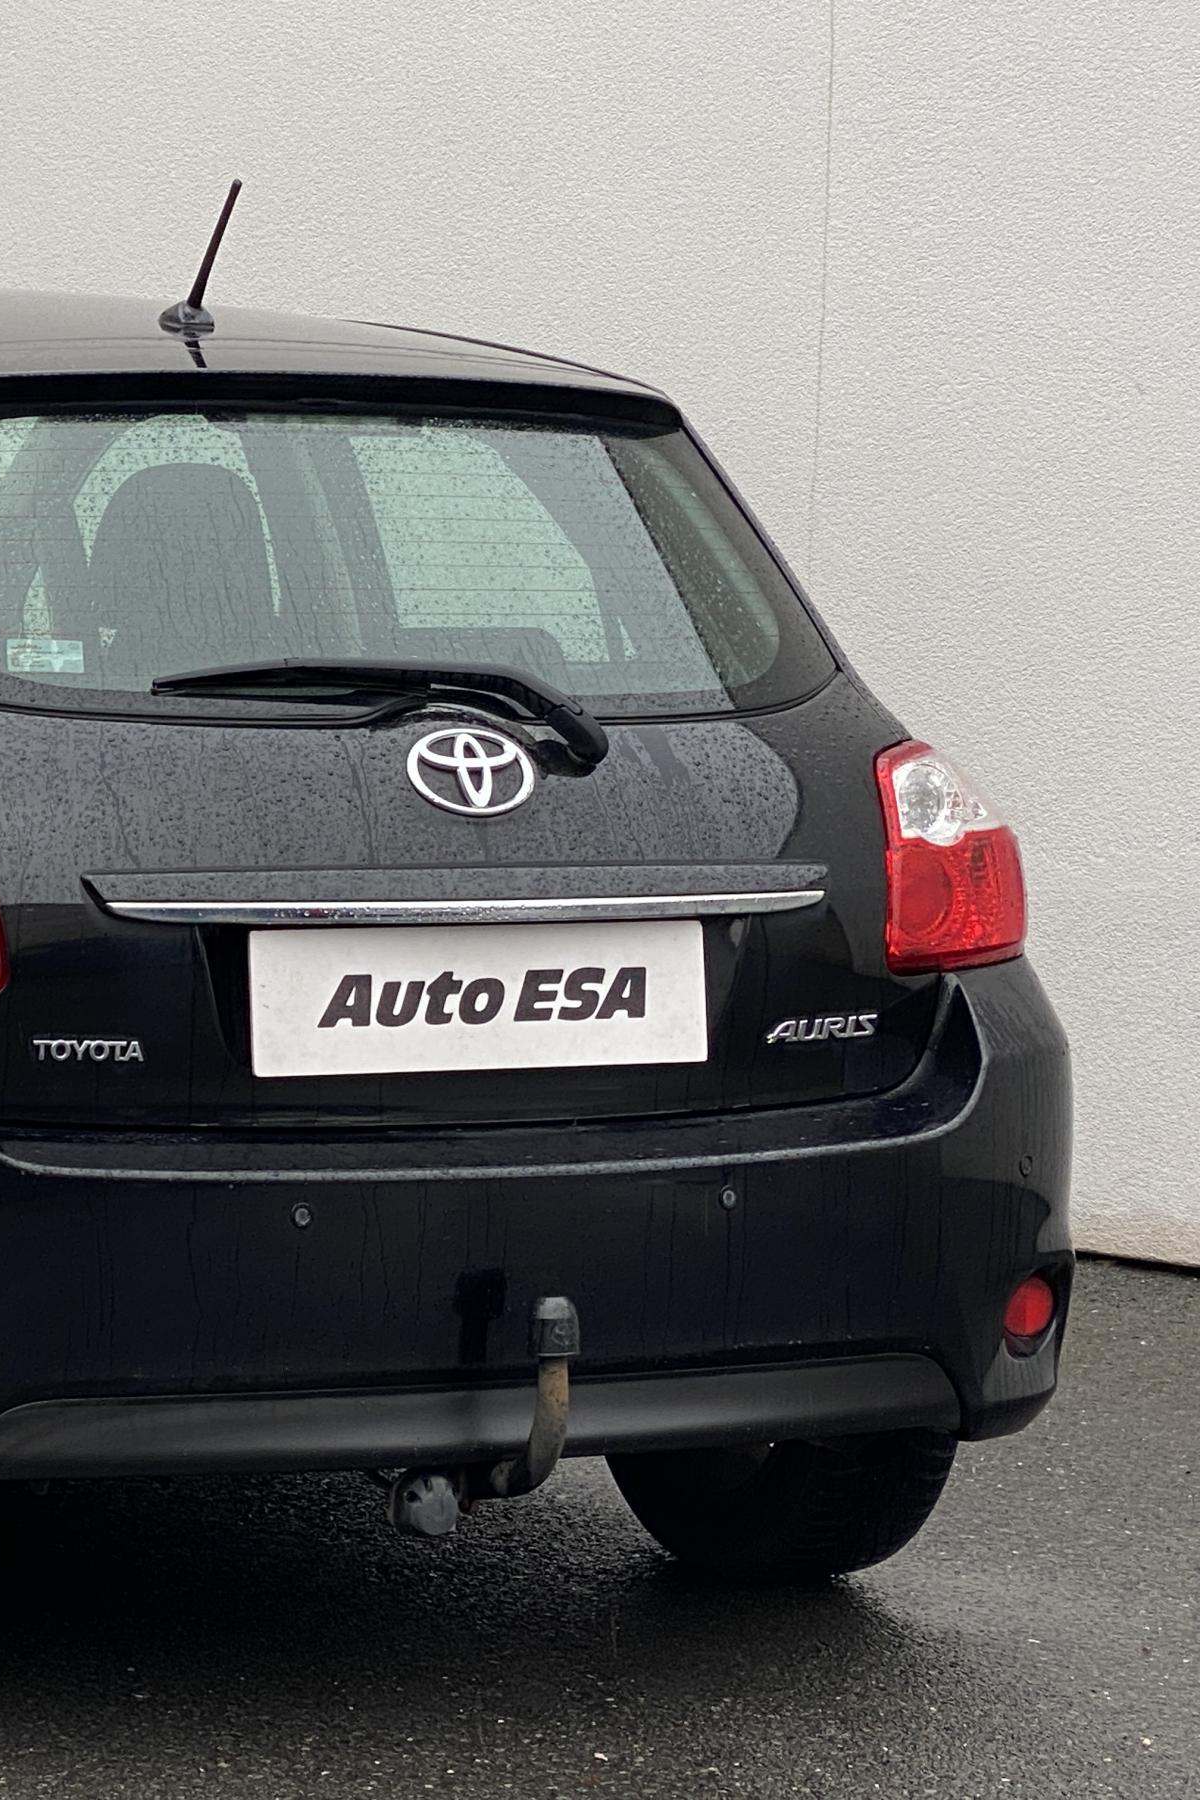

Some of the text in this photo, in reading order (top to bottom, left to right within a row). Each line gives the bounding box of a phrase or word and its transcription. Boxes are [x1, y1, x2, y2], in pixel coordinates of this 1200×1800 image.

[317, 966, 647, 1028] Auto ESA
[766, 1013, 878, 1044] AURIS
[32, 1038, 144, 1062] TOYOTA
